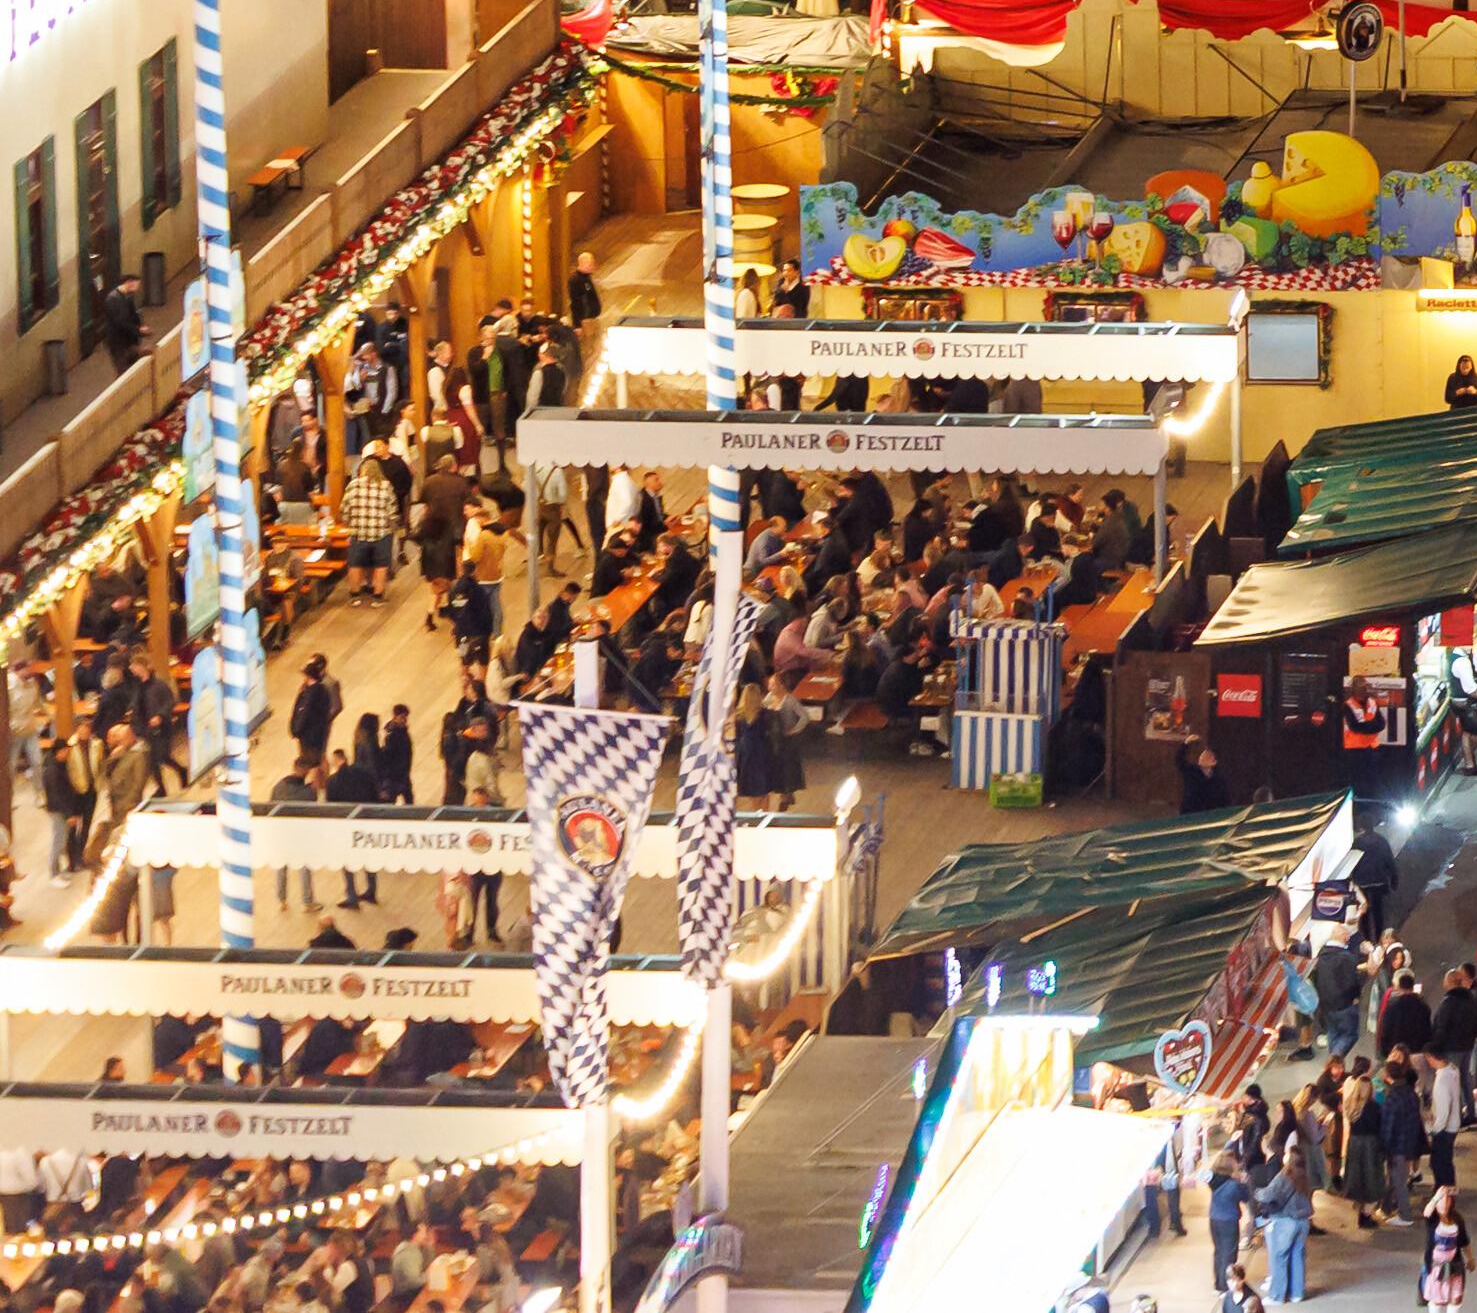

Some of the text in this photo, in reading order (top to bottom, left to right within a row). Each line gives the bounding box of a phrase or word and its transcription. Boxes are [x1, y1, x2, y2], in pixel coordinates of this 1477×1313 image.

[810, 339, 1028, 359] PAULANER FESTZELT
[721, 431, 946, 451] PAULANER FESTZELT
[1221, 688, 1258, 703] Coca-Cola
[351, 830, 461, 851] PAULANER
[220, 974, 472, 997] PAULANER FESTZELT
[91, 1111, 352, 1135] PAULANER FESTZELT
